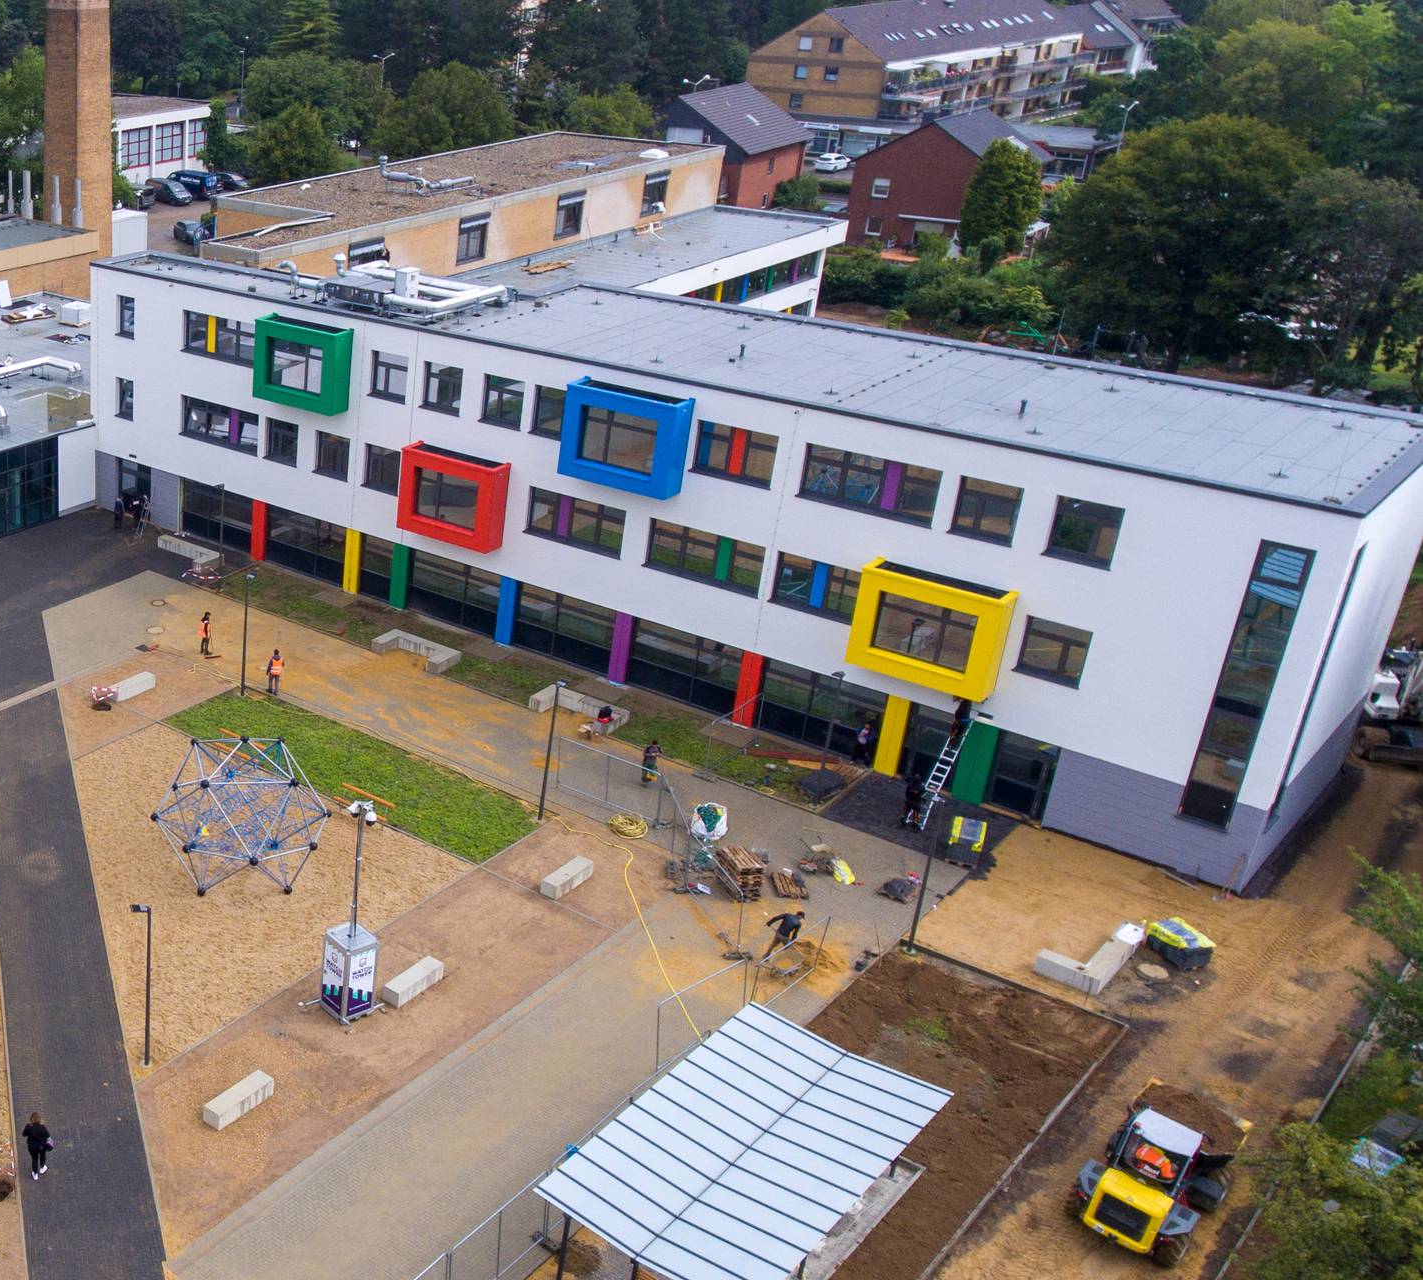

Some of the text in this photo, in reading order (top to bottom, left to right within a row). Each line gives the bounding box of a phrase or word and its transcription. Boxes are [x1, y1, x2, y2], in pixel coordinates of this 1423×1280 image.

[326, 958, 343, 975] WATCH
[326, 962, 342, 978] TOWER
[352, 966, 373, 976] WATCH
[352, 970, 372, 980] TOWER
